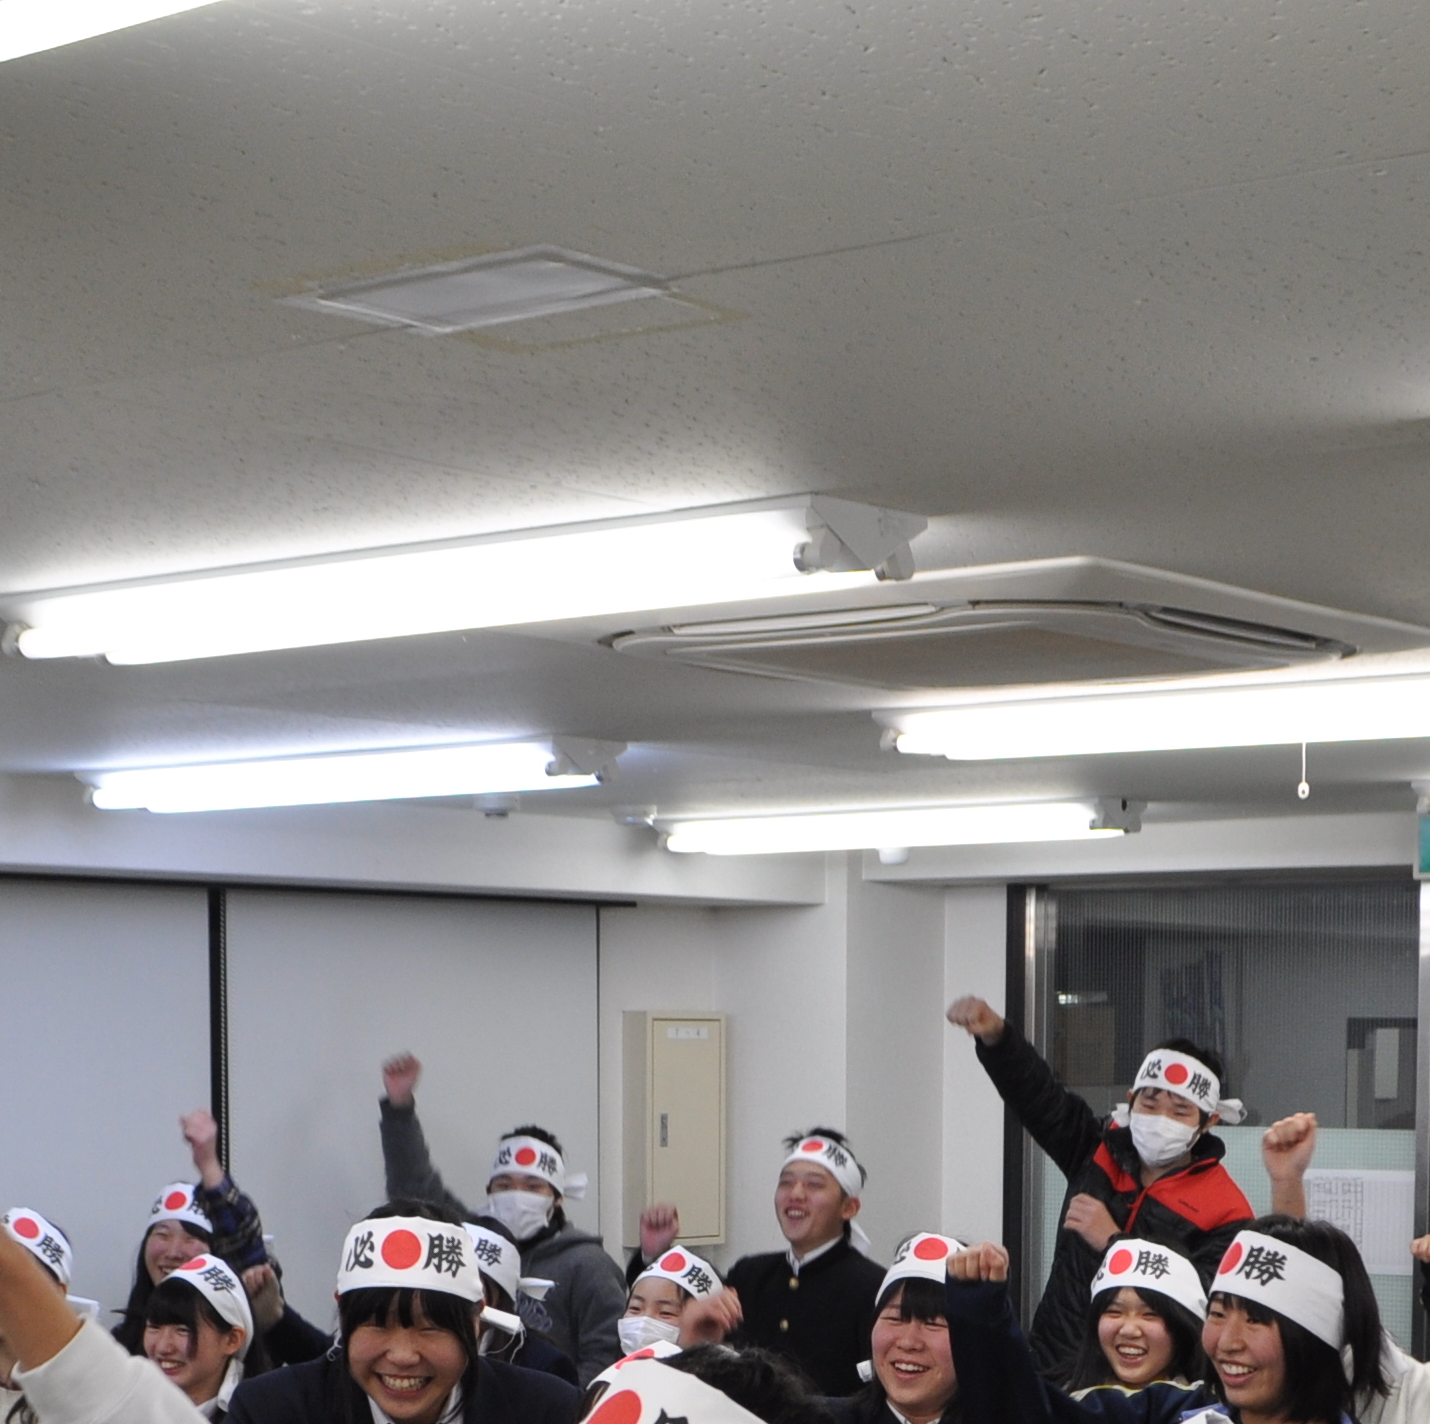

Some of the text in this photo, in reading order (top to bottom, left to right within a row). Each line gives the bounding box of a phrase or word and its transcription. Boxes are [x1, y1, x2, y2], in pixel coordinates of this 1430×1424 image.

[1140, 1059, 1212, 1099] 必 勝
[537, 1150, 559, 1175] 勝
[35, 1232, 65, 1266] 勝
[346, 1230, 467, 1277] 必 勝
[474, 1237, 503, 1267] 勝
[1133, 1249, 1172, 1280] 勝
[197, 1265, 237, 1293] 勝
[681, 1264, 714, 1295] 勝
[1236, 1245, 1289, 1287] 勝
